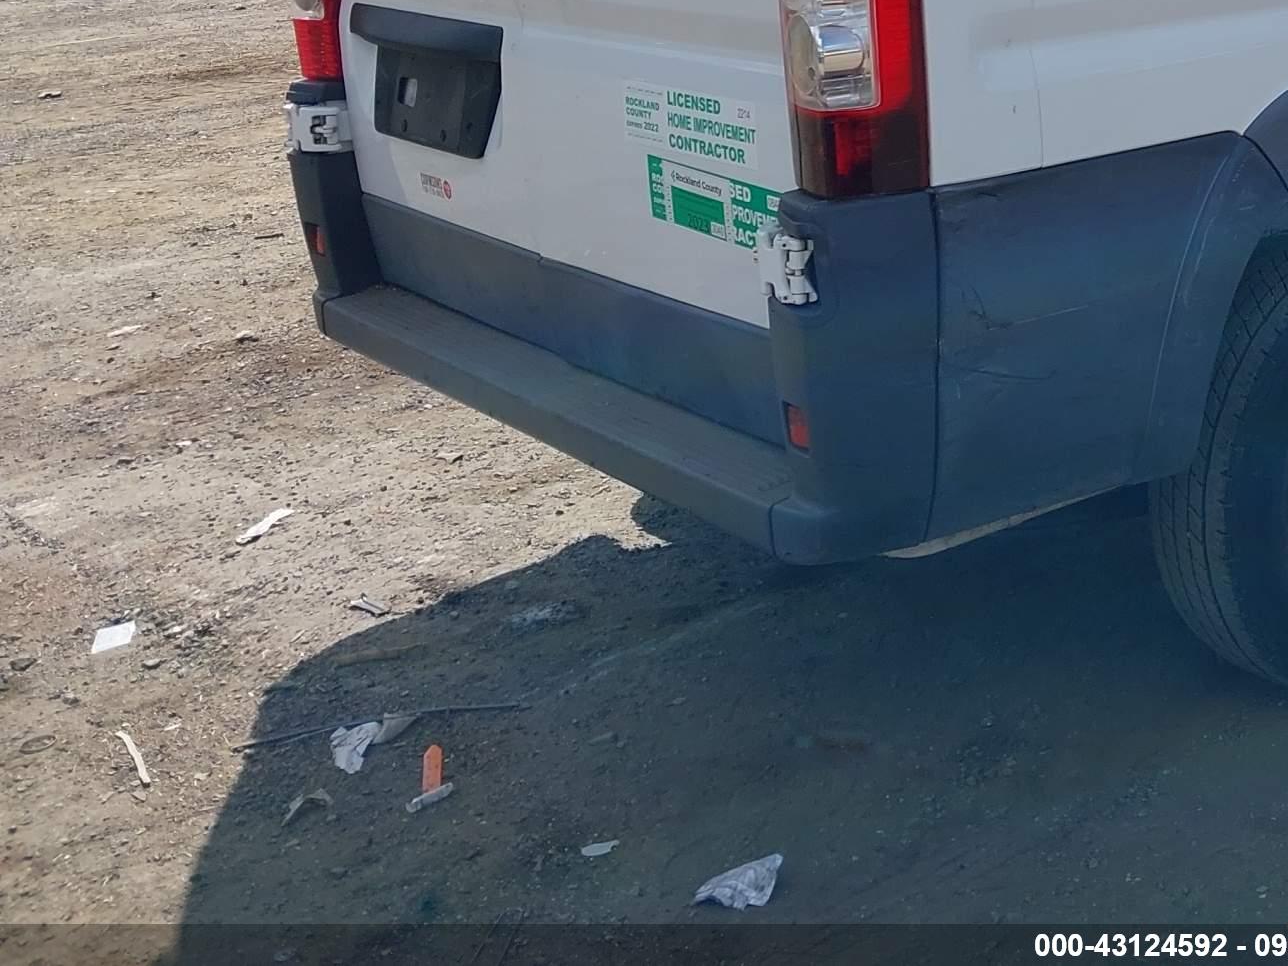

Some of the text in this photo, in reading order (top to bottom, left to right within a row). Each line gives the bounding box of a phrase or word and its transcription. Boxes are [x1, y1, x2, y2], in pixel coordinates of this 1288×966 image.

[625, 96, 660, 111] ROCKLAND
[625, 106, 652, 120] COUNTY
[667, 90, 721, 115] LICENSED
[667, 111, 756, 144] HOME IMPROVEMENT
[668, 133, 746, 165] CONTRACTOR
[675, 172, 701, 188] Rockland
[701, 180, 722, 197] County
